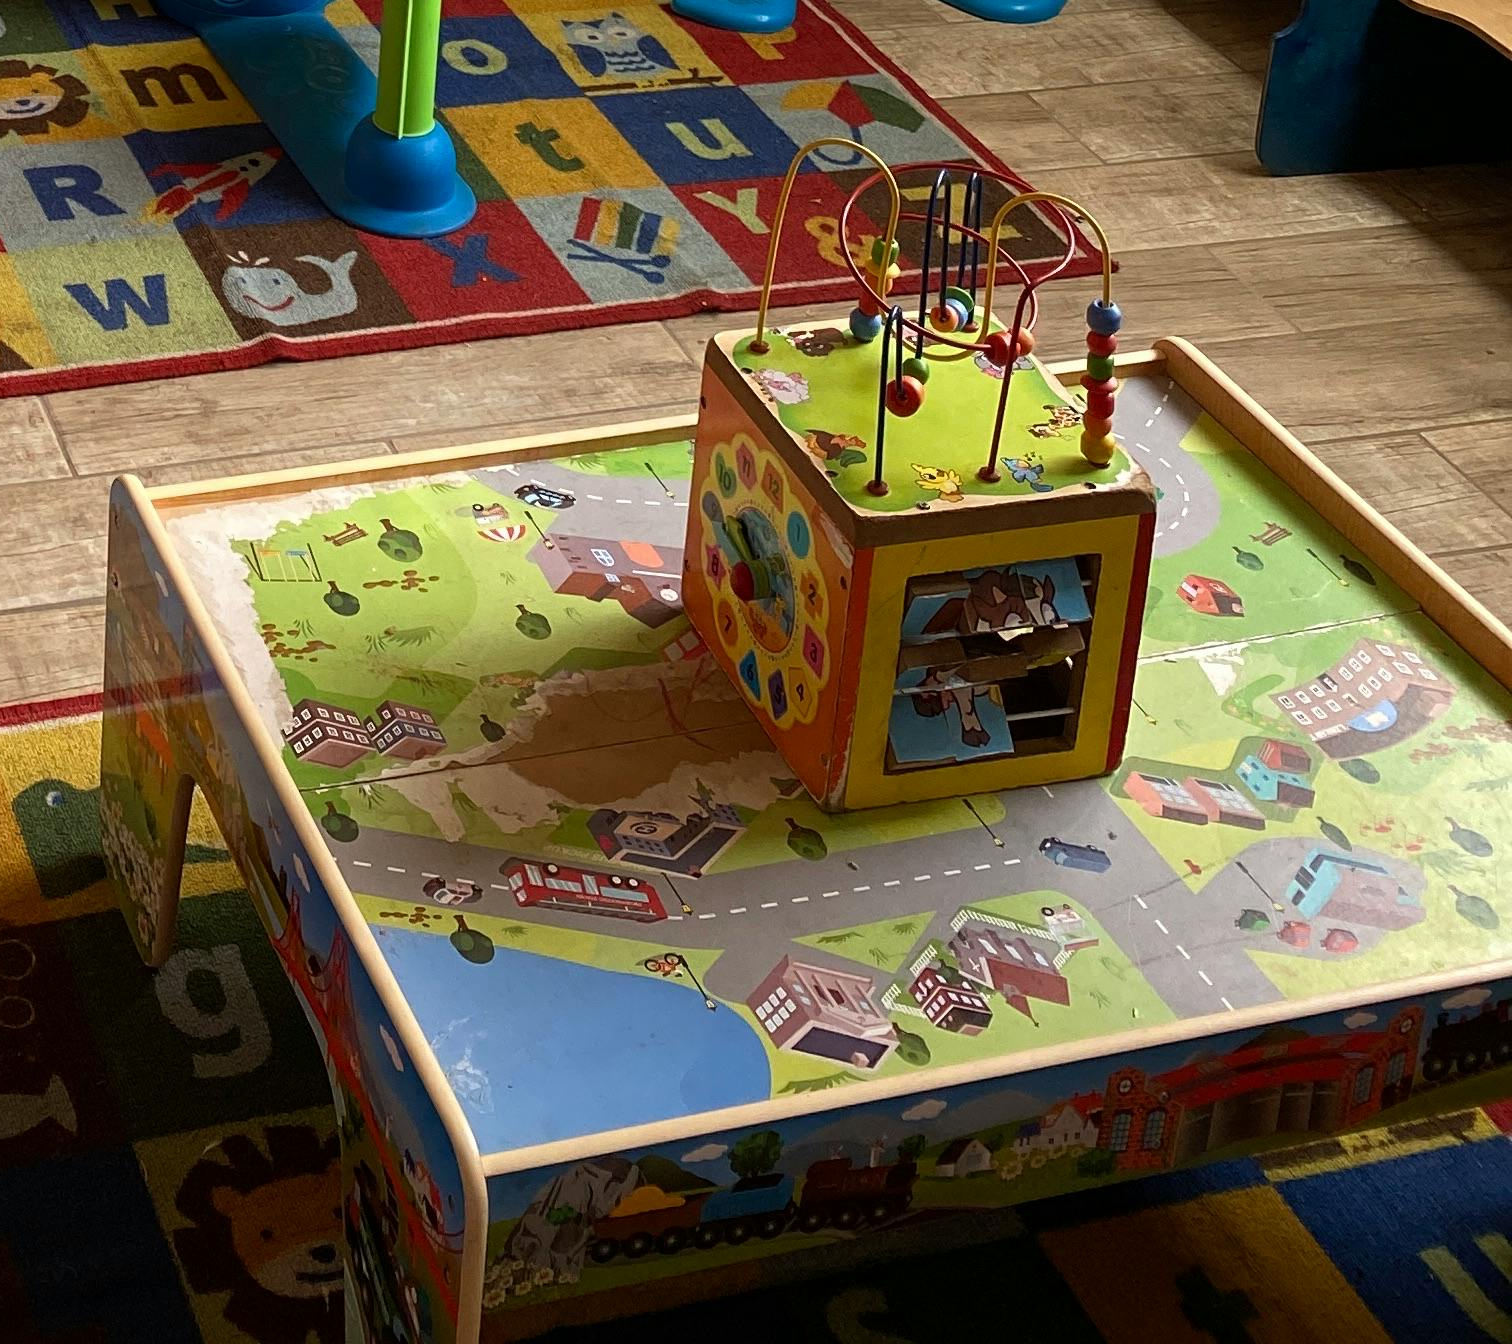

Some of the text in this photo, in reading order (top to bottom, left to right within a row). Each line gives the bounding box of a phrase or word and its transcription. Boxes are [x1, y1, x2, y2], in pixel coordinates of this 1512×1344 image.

[120, 62, 227, 108] m
[666, 118, 754, 160] u
[23, 163, 128, 221] R
